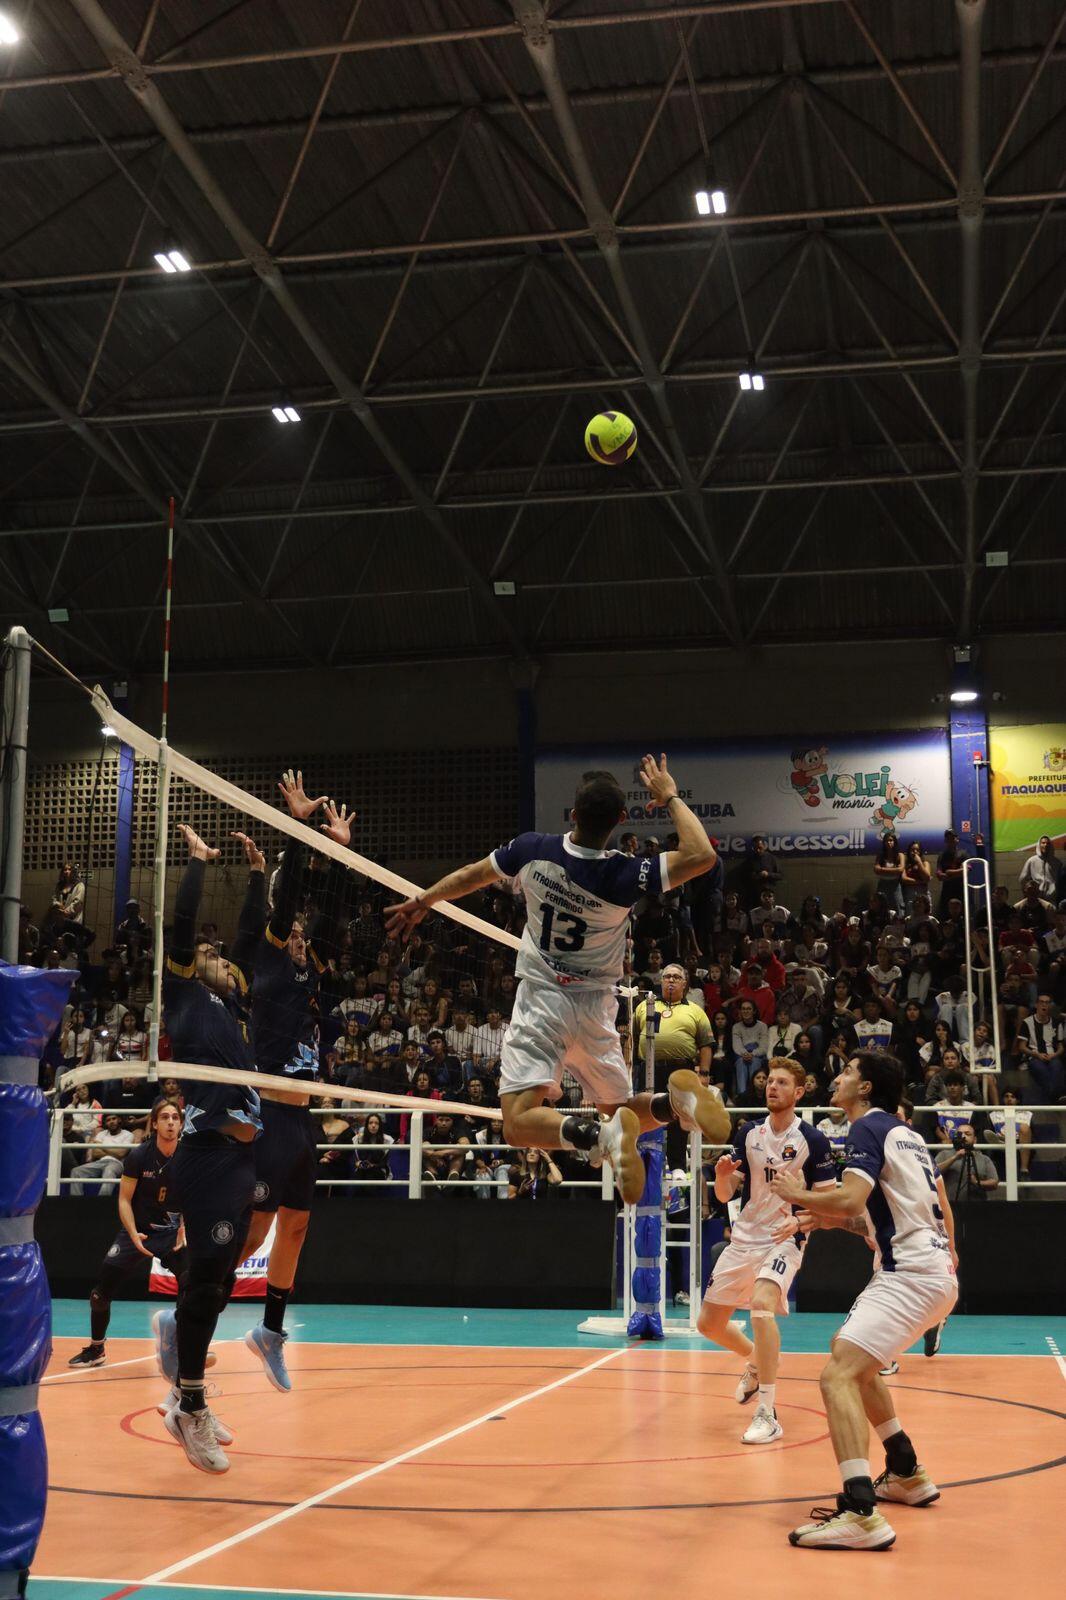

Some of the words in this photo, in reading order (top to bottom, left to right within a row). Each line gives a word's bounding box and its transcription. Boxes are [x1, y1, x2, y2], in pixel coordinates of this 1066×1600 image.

[678, 789, 693, 799] DE
[832, 797, 875, 810] mania
[718, 834, 747, 853] de
[638, 857, 652, 892] APEX
[545, 891, 583, 914] FERNANDO
[539, 902, 587, 952] 13
[241, 1257, 269, 1268] ETU
[771, 1258, 787, 1275] 10
